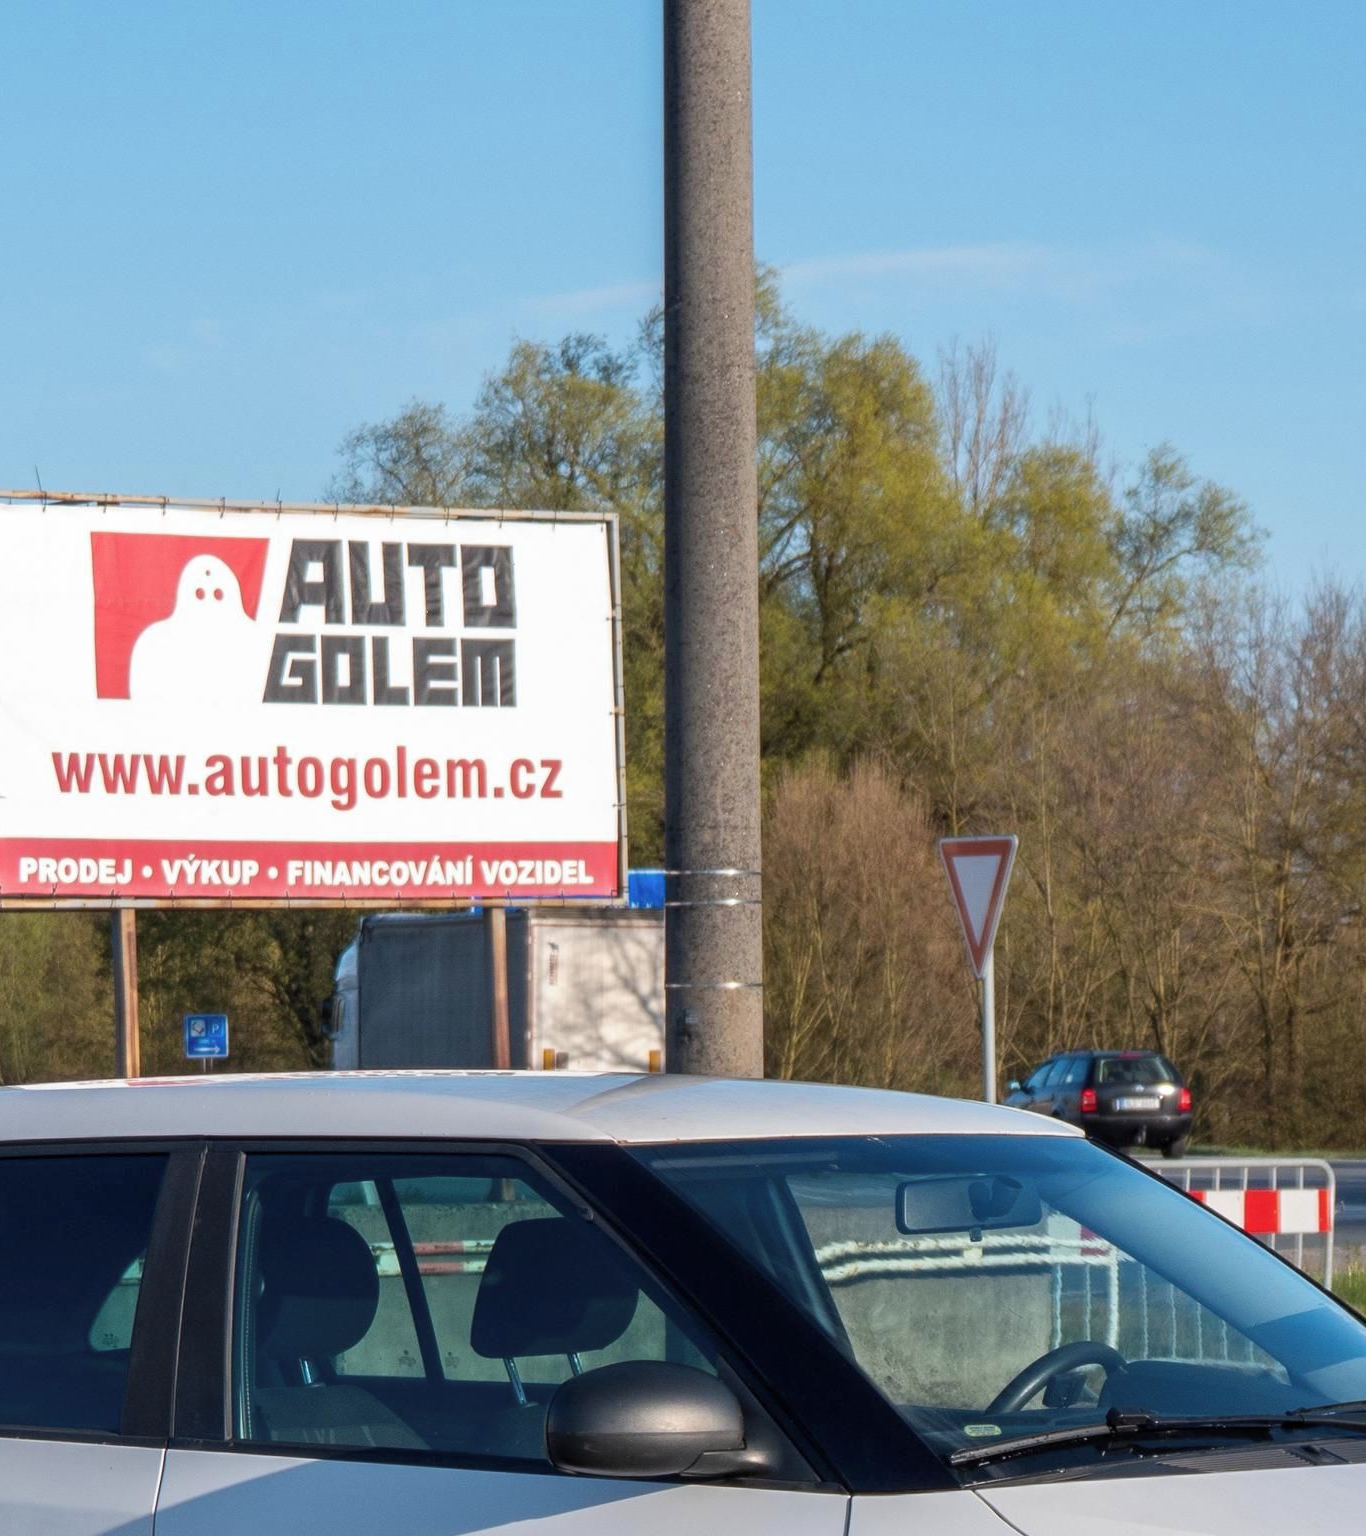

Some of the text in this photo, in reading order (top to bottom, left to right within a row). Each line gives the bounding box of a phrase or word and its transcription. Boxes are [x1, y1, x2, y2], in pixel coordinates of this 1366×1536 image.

[279, 539, 517, 628] AUTO
[263, 634, 517, 707] GOLEM
[51, 746, 563, 811] www.autogolem.cz
[19, 854, 594, 886] PRODEJ VÝKUP FINANCOVÁNÍ VOZIDEL
